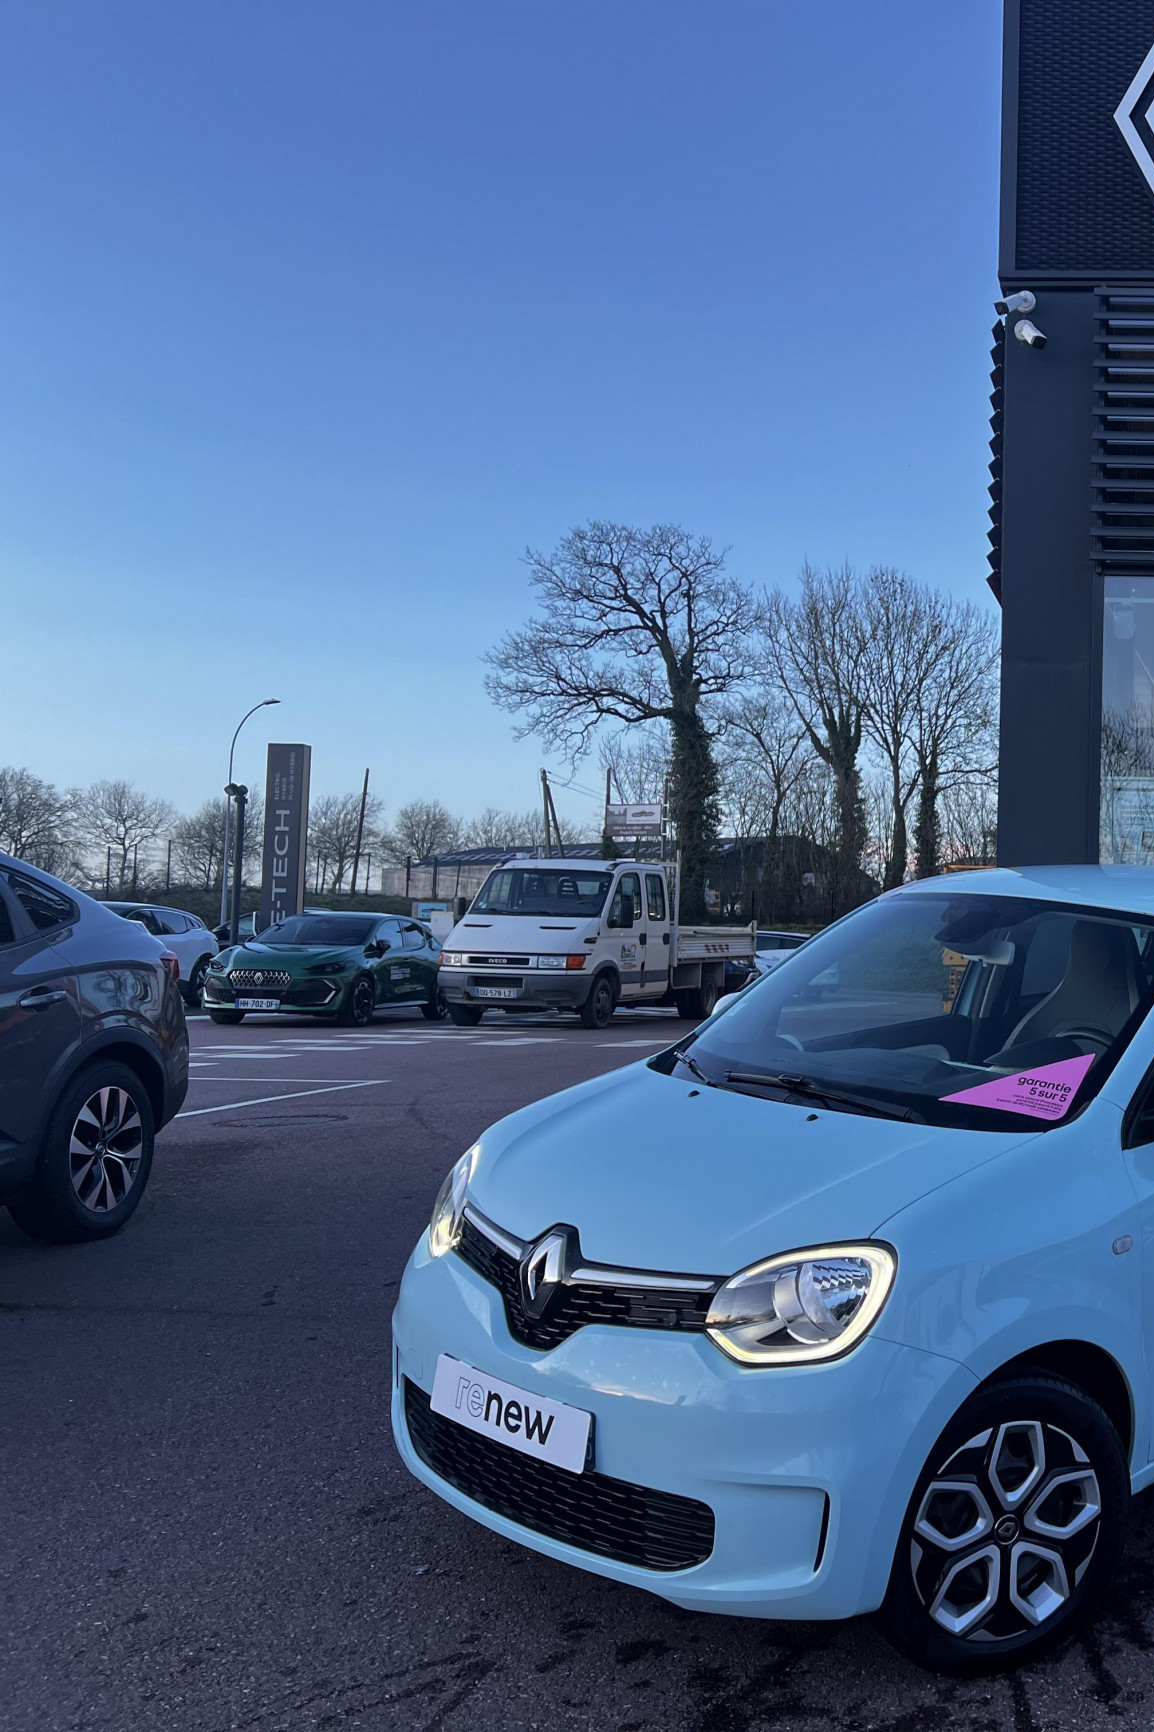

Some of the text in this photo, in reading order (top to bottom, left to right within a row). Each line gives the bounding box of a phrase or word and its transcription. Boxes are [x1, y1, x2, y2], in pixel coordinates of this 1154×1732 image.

[271, 809, 290, 926] E-TECH
[1017, 1077, 1072, 1094] garantie
[1029, 1087, 1069, 1103] 5 sur 5
[455, 1377, 555, 1446] renew
